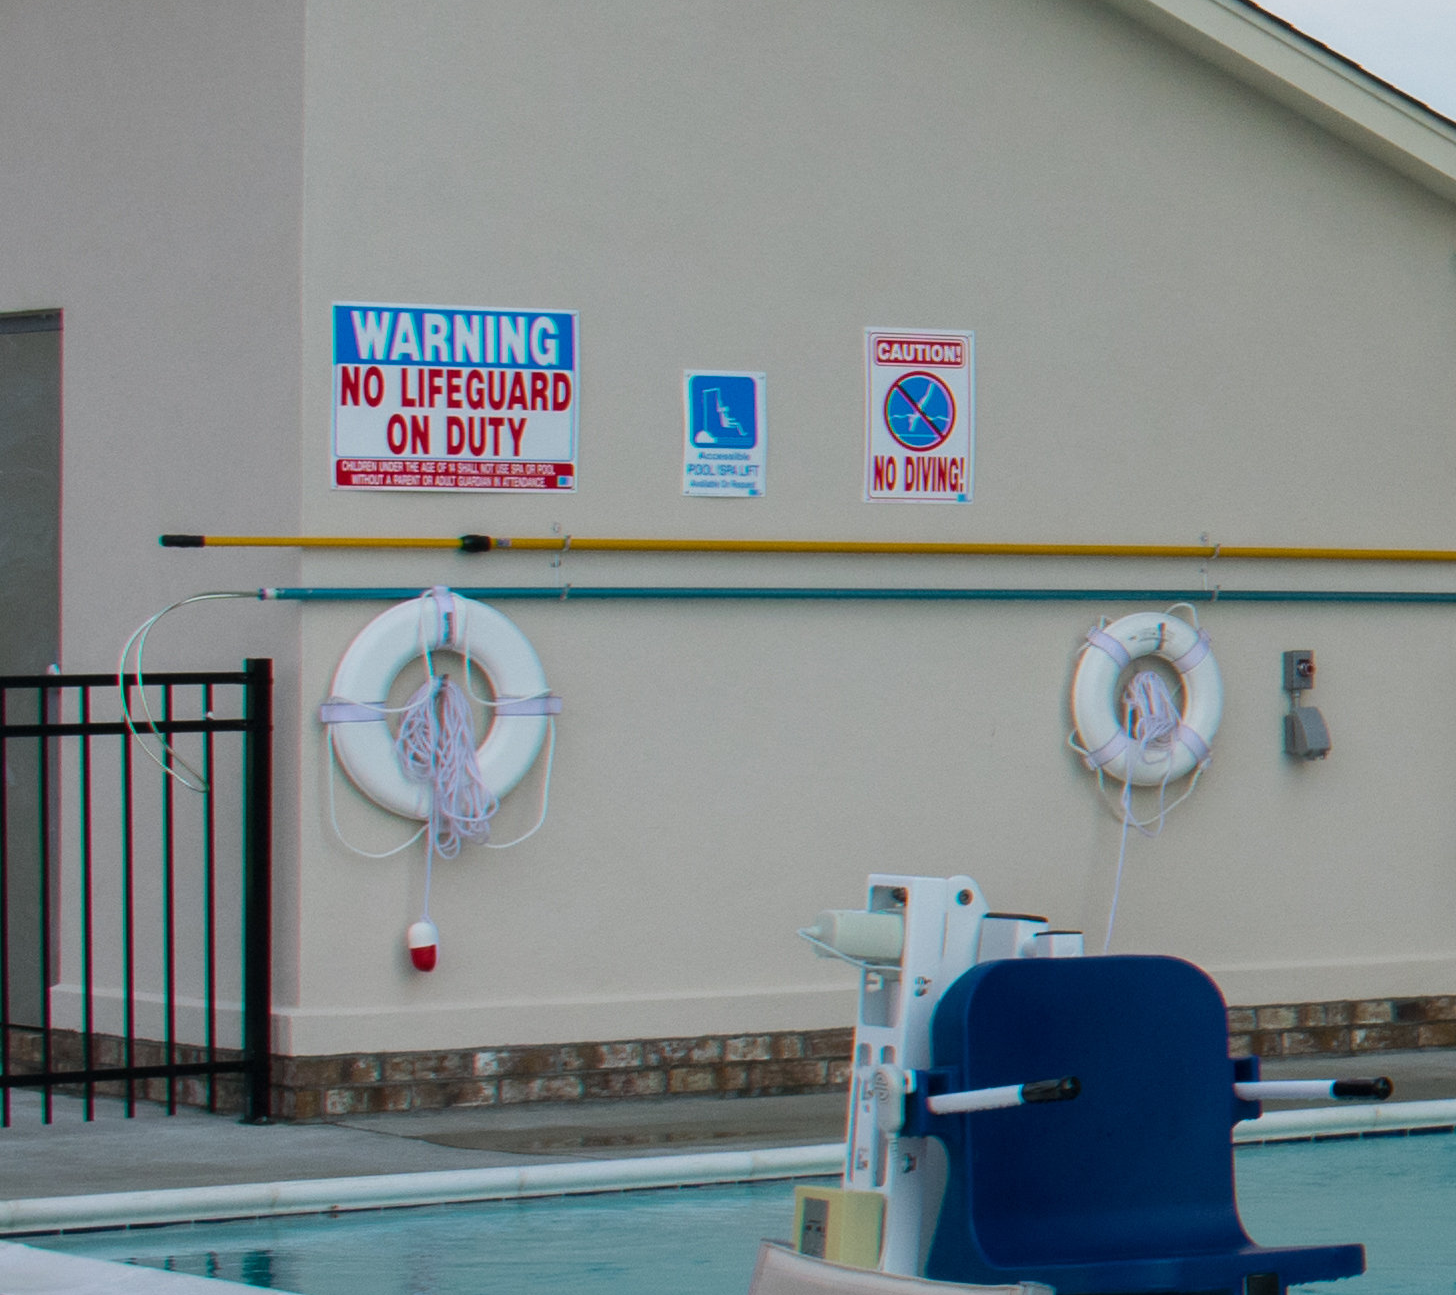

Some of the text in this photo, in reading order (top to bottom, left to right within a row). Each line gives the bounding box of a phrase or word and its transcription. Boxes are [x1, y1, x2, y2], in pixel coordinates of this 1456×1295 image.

[351, 310, 560, 366] WARNING
[878, 342, 962, 363] CAUTION!
[341, 366, 572, 412] NO LIFEGUARD
[387, 413, 528, 457] ON DUTY
[341, 460, 378, 472] CHILDREN
[379, 461, 404, 472] UNDER
[405, 462, 420, 473] THE
[421, 462, 436, 473] AGE
[437, 462, 447, 473] OF
[480, 463, 494, 474] NOT
[495, 464, 510, 474] USE
[351, 474, 385, 485] WITHOUT
[385, 475, 392, 485] A
[393, 475, 421, 485] PARENT
[422, 475, 433, 486] OR
[434, 475, 456, 486] ADULT
[457, 476, 492, 487] GUARDIAN
[873, 455, 965, 493] NO DIVING!
